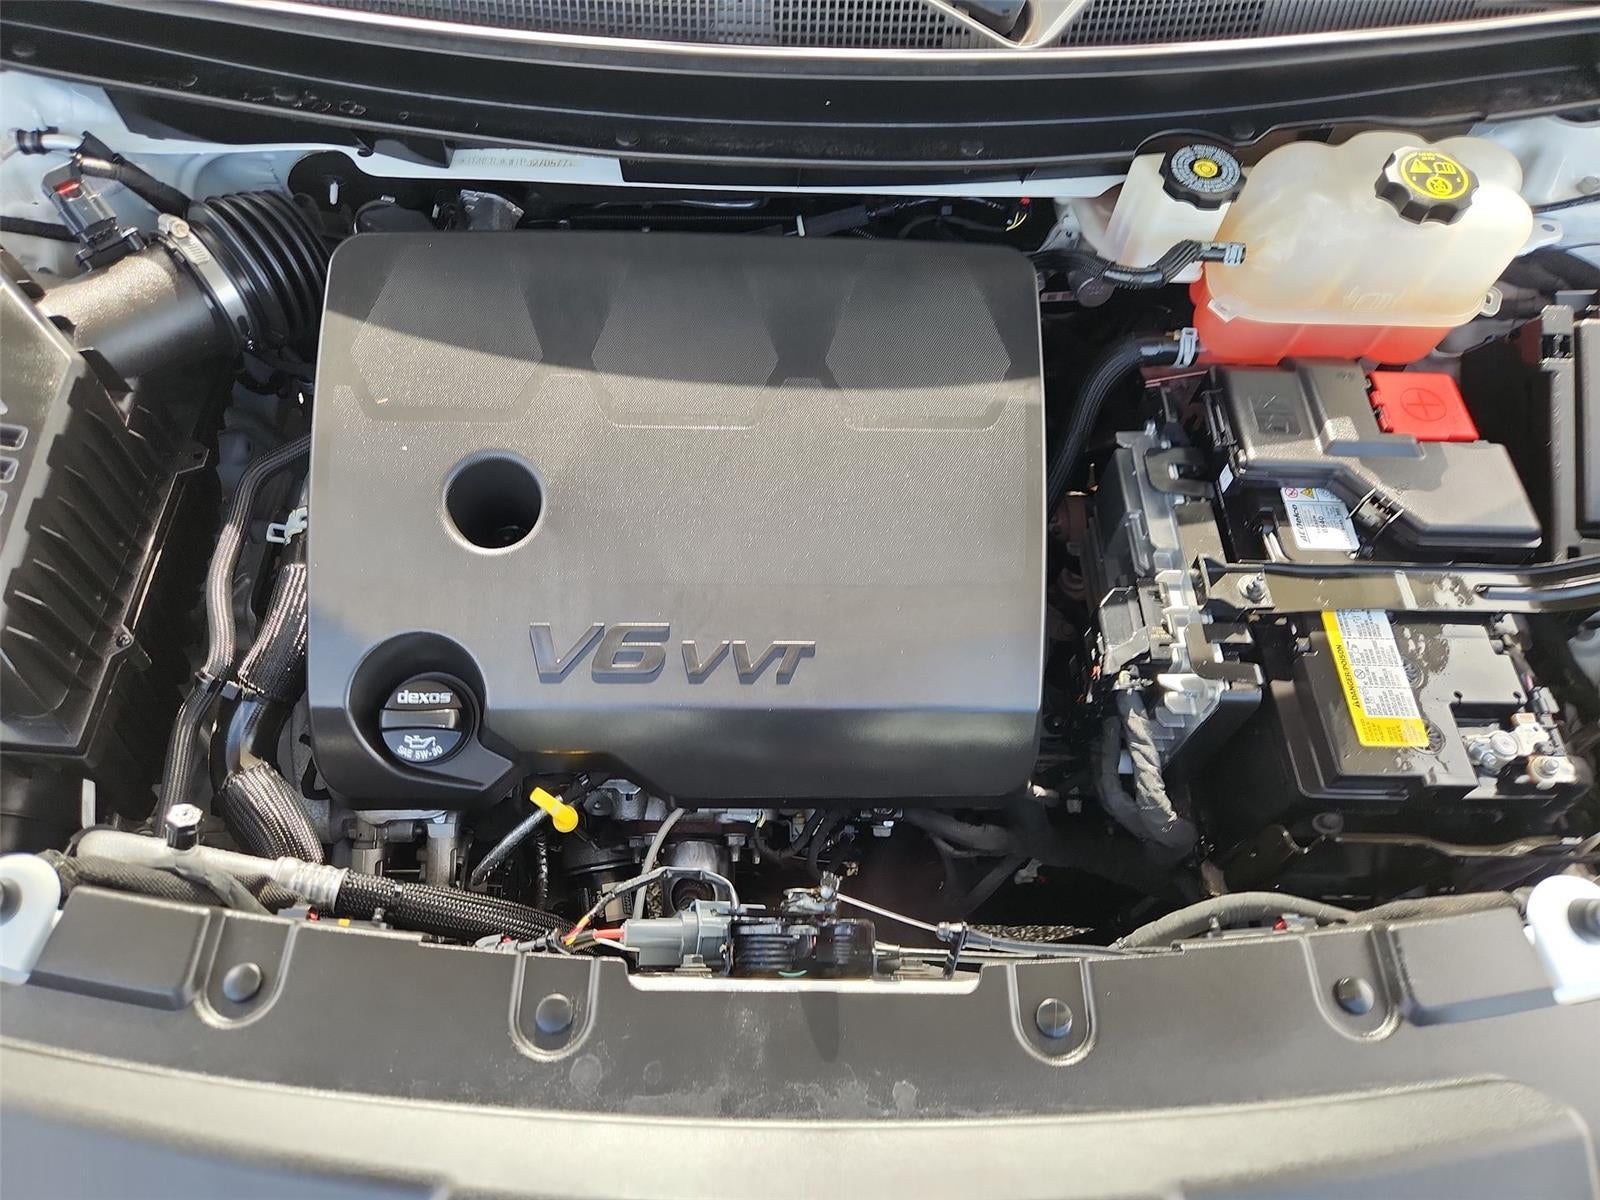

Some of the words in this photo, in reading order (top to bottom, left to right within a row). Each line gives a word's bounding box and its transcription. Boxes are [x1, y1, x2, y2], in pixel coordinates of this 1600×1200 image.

[529, 622, 671, 684] V6
[681, 640, 816, 685] VVT
[397, 690, 452, 704] dexos
[397, 745, 413, 758] SAE
